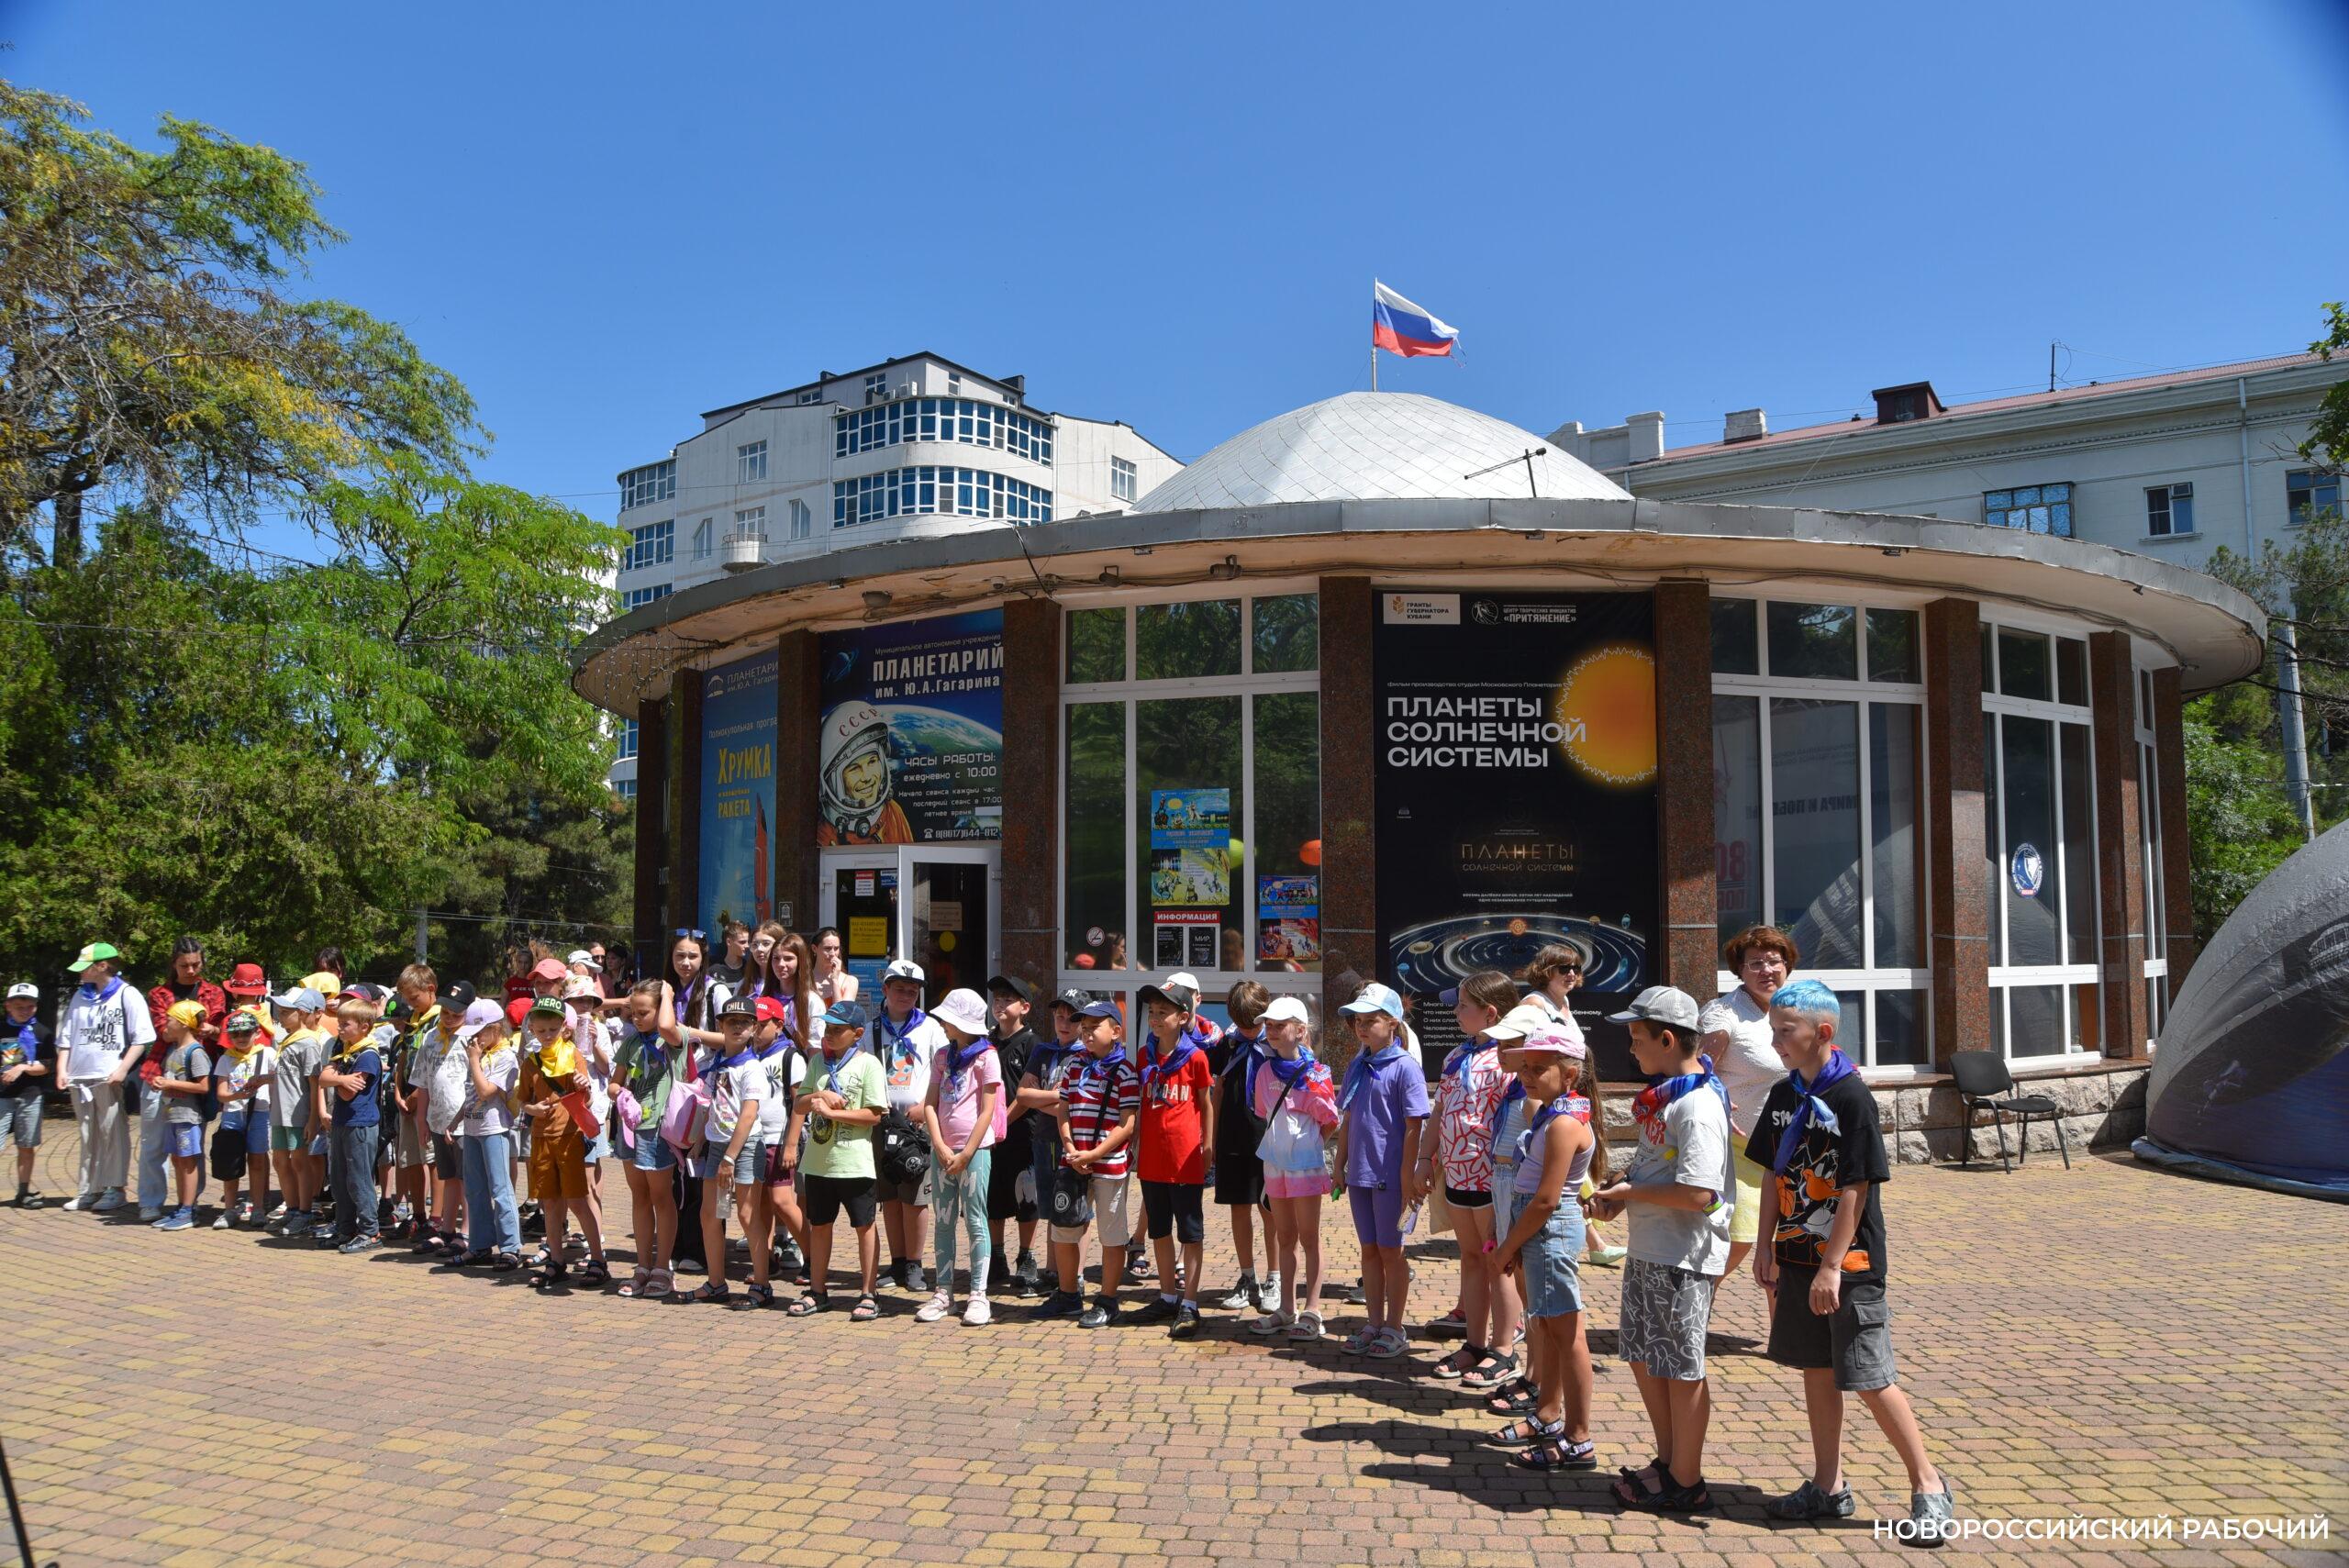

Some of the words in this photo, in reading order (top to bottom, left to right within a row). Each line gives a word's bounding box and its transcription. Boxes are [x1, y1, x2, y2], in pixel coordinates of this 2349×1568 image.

[1503, 614, 1576, 623] «ПРИТЯЖЕНИЕ»
[873, 641, 1004, 682] ПЛАНЕТАРИЙ
[727, 661, 778, 684] ПЛАНЕТАРИ
[875, 686, 898, 698] им.
[1387, 696, 1542, 717] ПЛАНЕТЫ
[839, 707, 878, 737] СССР
[1386, 717, 1586, 742] СОЛНЕЧНОЙ
[904, 755, 937, 767] ЧАСЫ
[942, 751, 996, 765] РАБОТЫ:
[1386, 747, 1549, 767] СИСТЕМЫ
[903, 772, 951, 783] ежедневно
[966, 765, 996, 778] 10:00
[952, 787, 979, 795] каждый
[718, 798, 751, 819] РАКЕТА
[913, 799, 948, 807] последний
[1462, 843, 1573, 860] ПЛАНЕТЫ
[1157, 913, 1218, 921] ИНФОРМАЦИЯ
[538, 997, 562, 1009] HERO
[726, 1002, 745, 1012] CHILL
